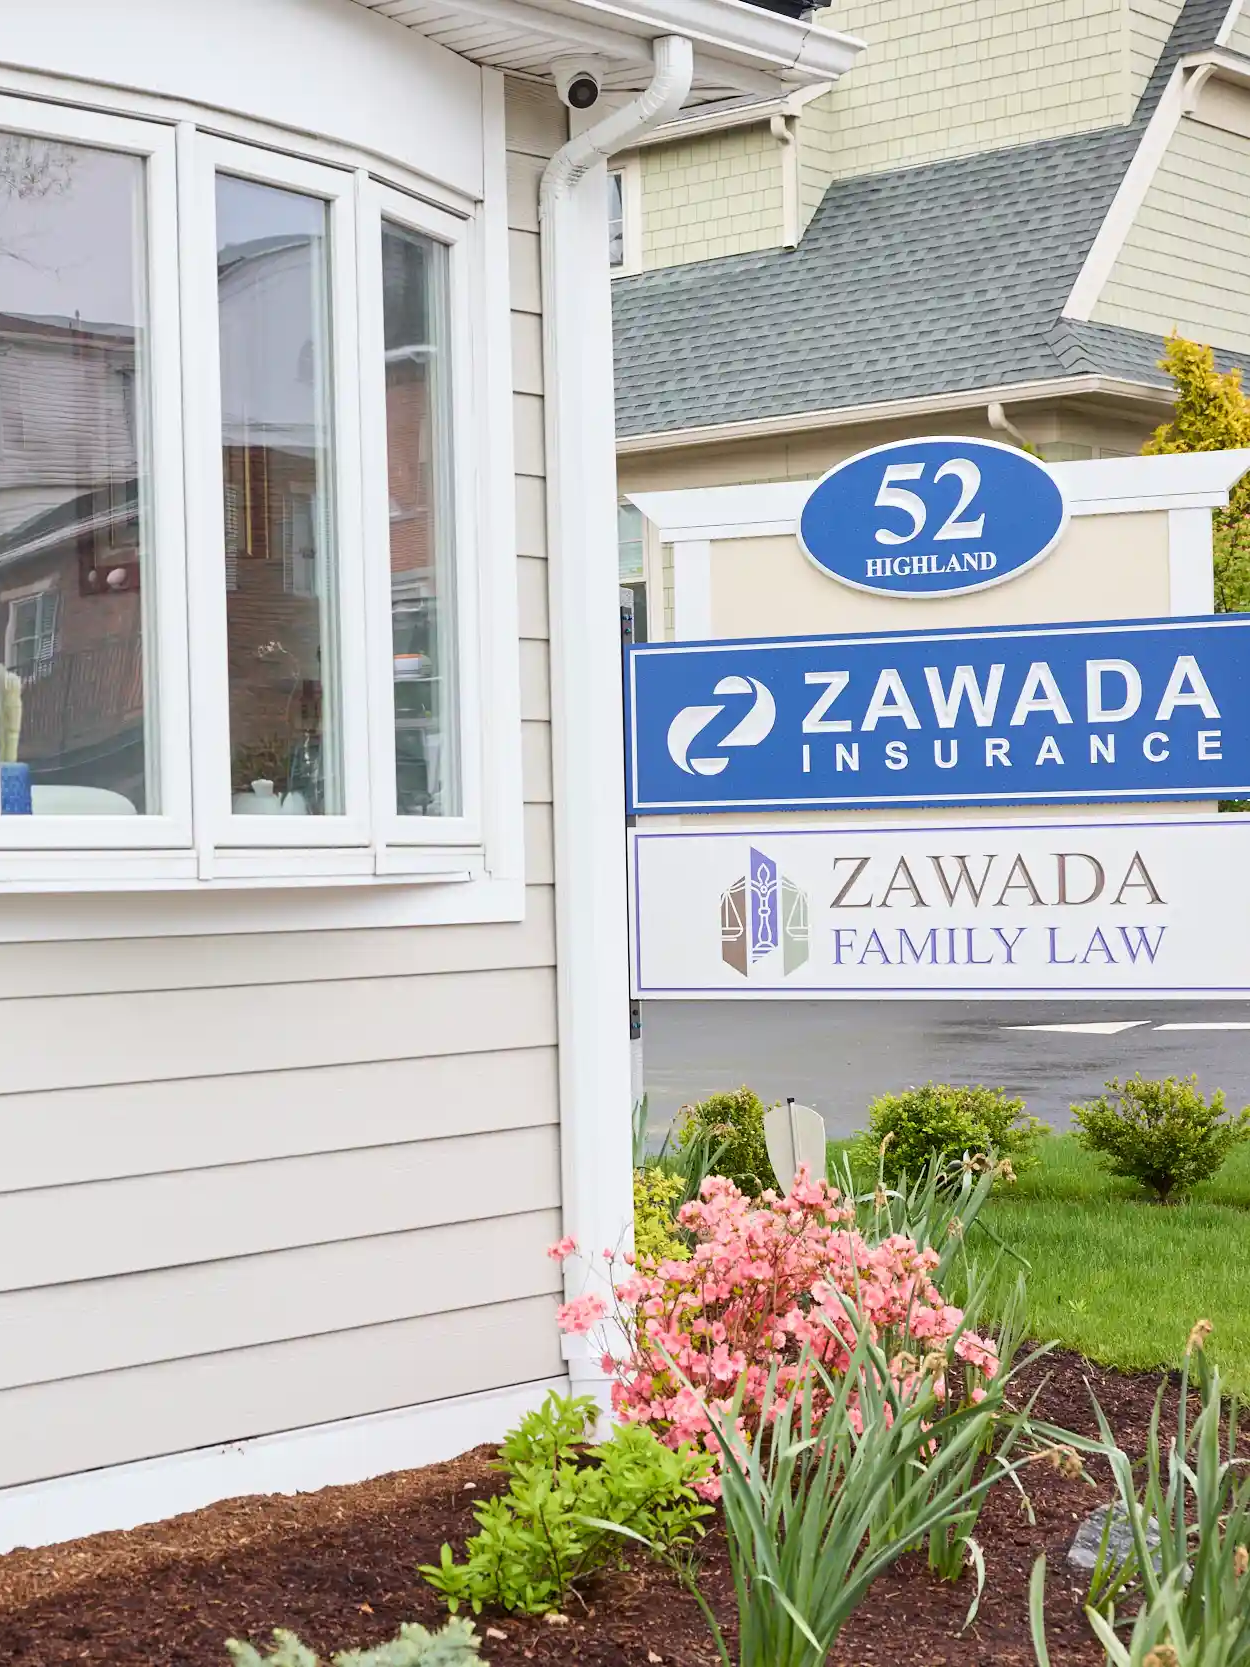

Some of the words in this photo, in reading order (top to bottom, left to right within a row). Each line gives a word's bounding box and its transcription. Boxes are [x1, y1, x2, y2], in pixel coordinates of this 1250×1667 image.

[873, 457, 986, 546] 52
[865, 551, 997, 578] HIGHLAND
[801, 655, 1223, 734] ZAWADA
[802, 729, 1224, 773] INSURANCE
[829, 850, 1169, 909] ZAWADA
[830, 926, 1028, 965] FAMILY
[1044, 926, 1169, 965] LAW
